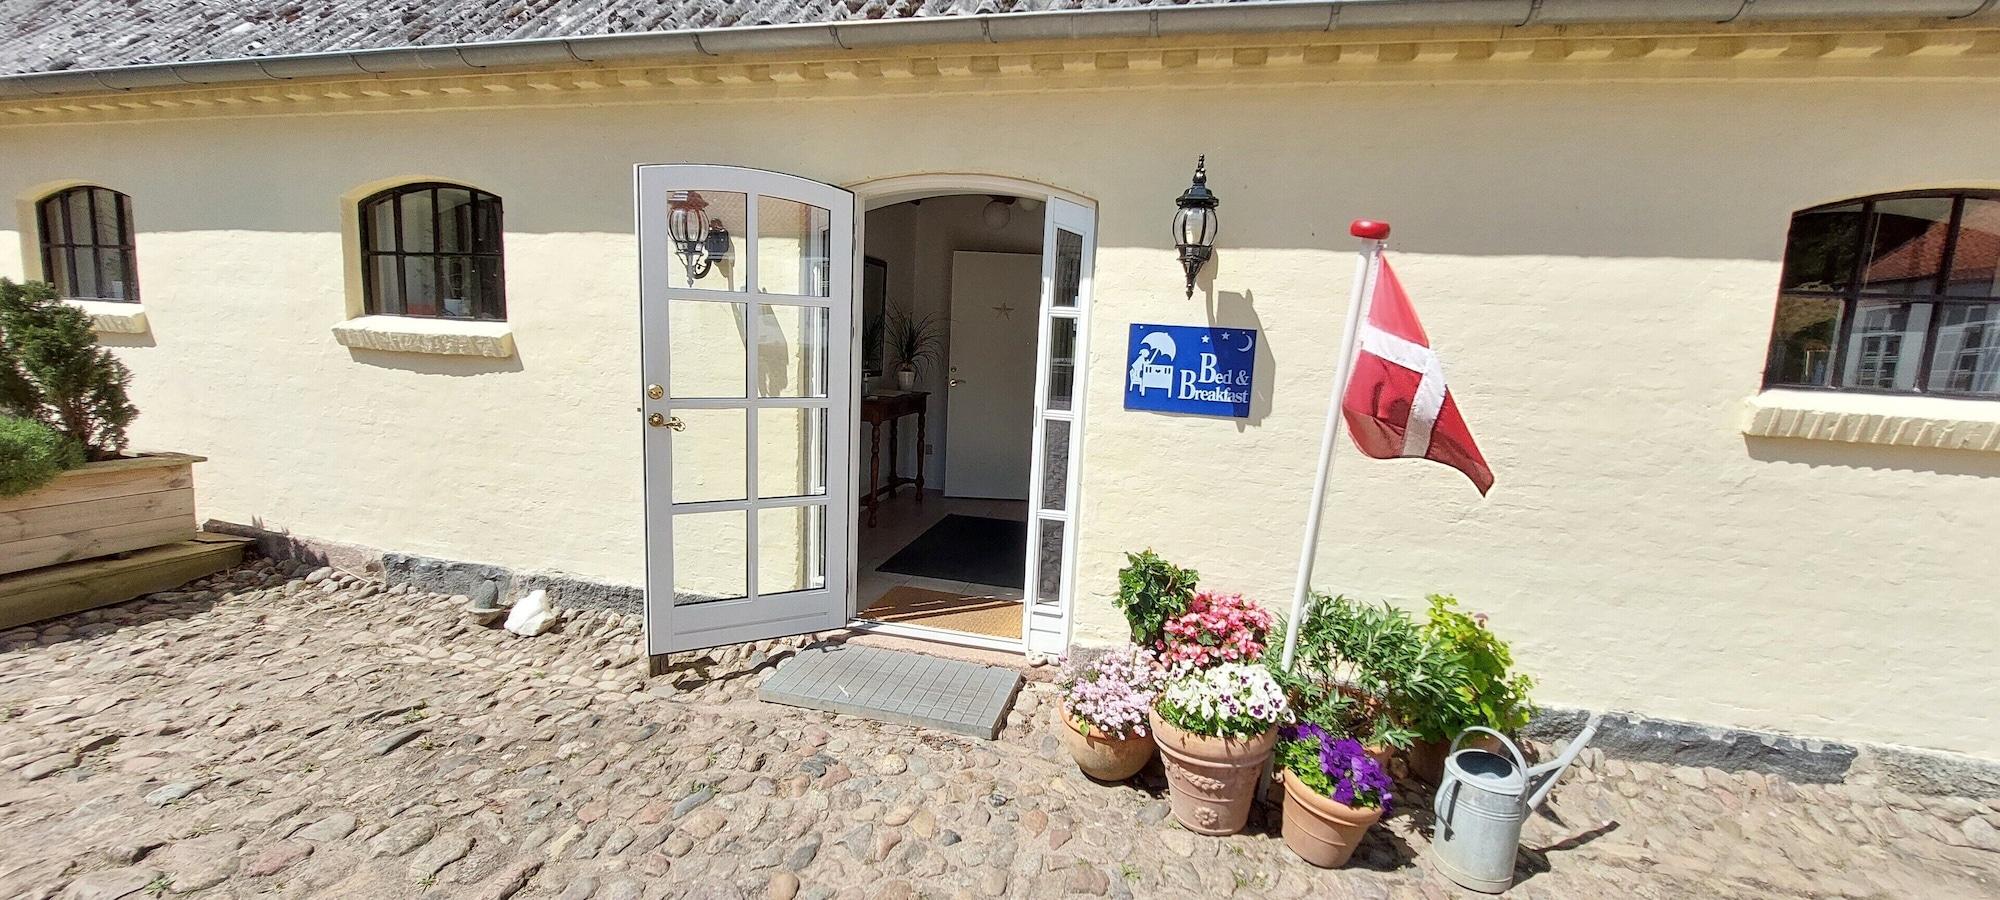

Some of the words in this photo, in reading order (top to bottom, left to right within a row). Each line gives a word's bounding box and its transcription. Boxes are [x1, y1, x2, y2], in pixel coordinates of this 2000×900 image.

[1178, 369, 1249, 403] Breakfast
[1198, 352, 1232, 384] Bed
[1235, 370, 1249, 386] &
